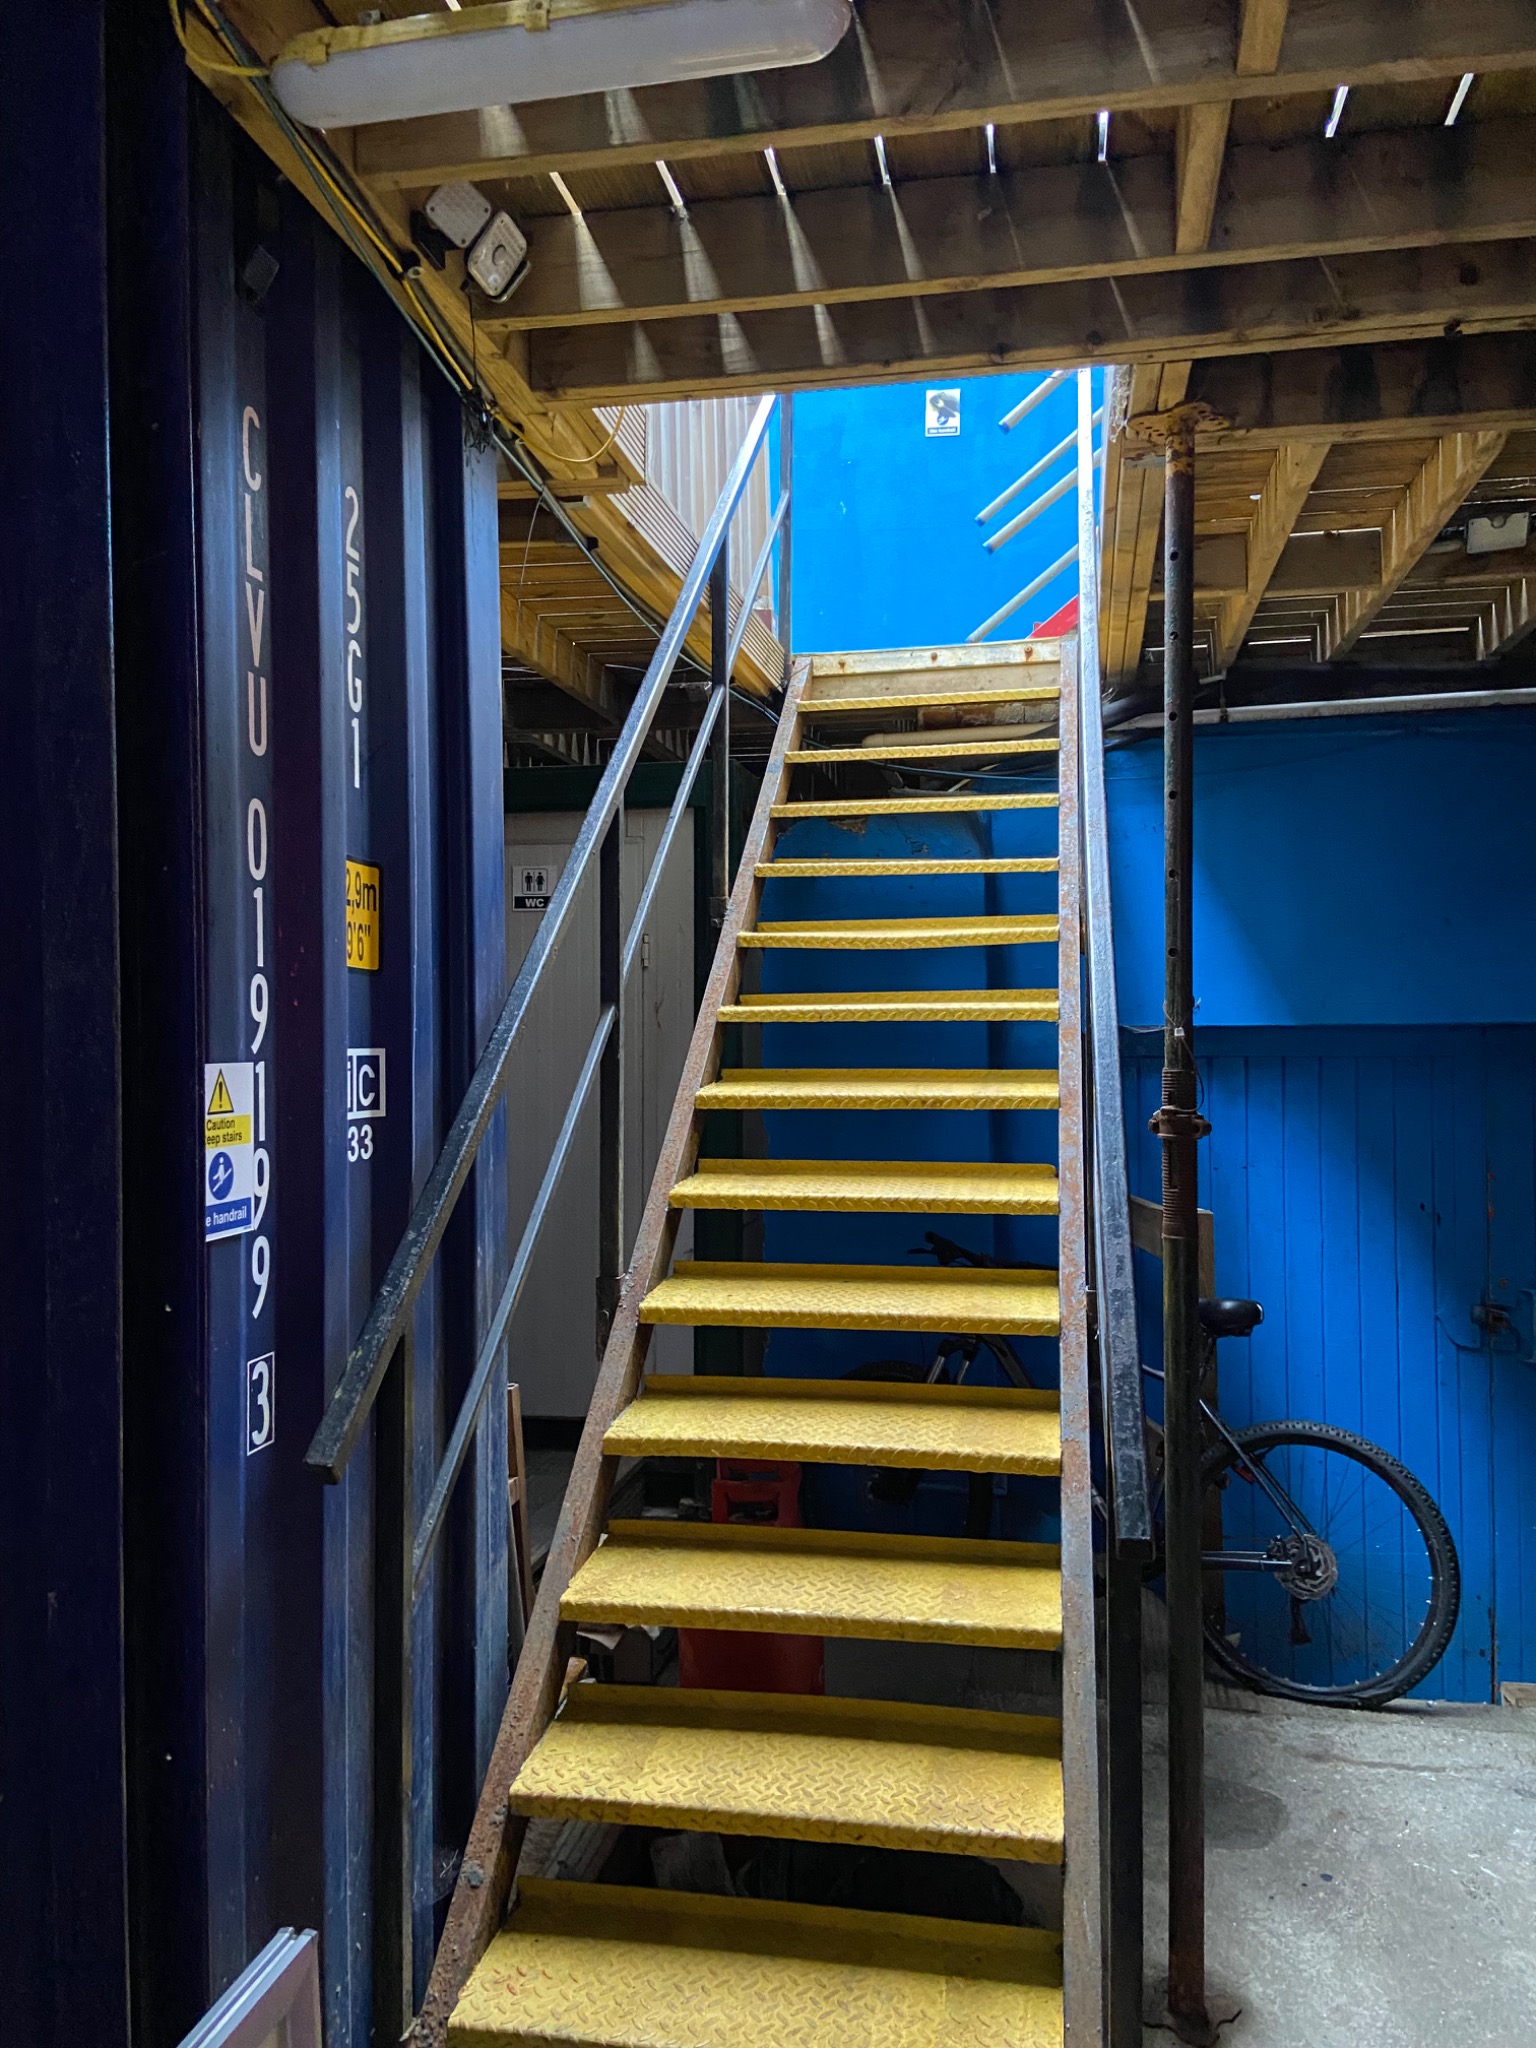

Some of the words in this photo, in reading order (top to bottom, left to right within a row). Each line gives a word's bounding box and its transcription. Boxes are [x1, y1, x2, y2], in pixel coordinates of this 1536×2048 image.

[242, 405, 267, 757] CLVU
[345, 485, 362, 789] 25G1
[525, 898, 545, 908] WC
[247, 797, 270, 1320] 019199
[205, 1134, 220, 1147] eep
[222, 1130, 242, 1143] stairs
[206, 1117, 235, 1131] Caution
[347, 1124, 373, 1162] 33
[213, 1205, 247, 1226] handrail
[251, 1360, 270, 1446] 3
